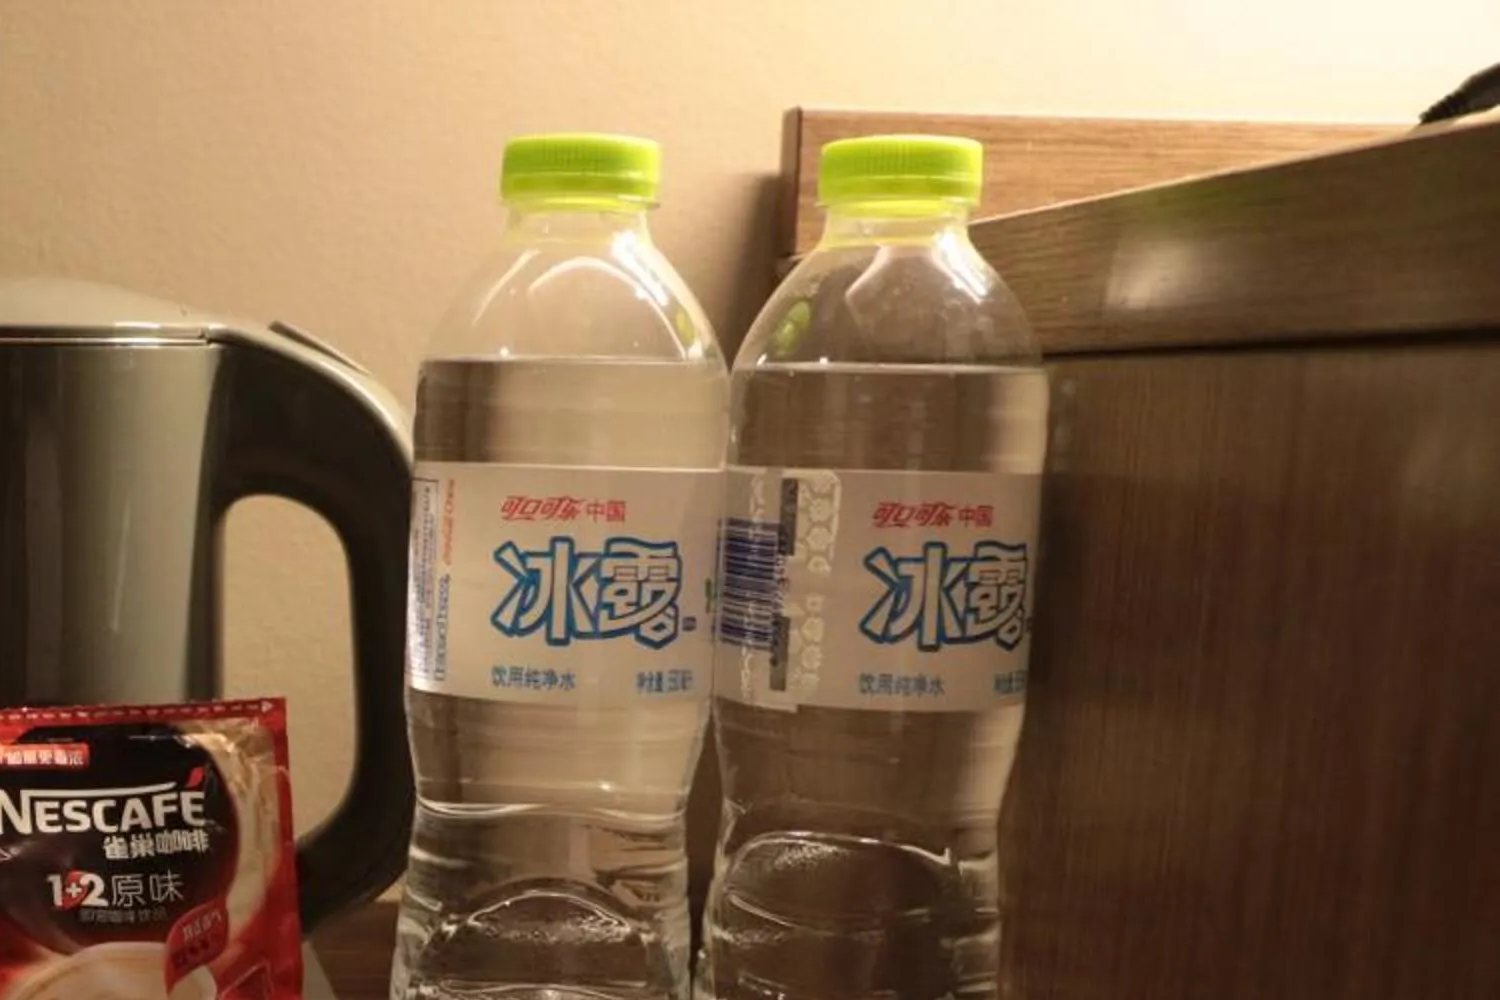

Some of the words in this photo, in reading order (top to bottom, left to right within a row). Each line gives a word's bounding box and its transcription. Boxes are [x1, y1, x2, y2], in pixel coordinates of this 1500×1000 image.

[490, 536, 682, 650] 冰露
[859, 540, 1027, 651] 冰露
[492, 666, 576, 691] 饮用纯净水
[102, 831, 209, 859] 雀巢咖啡
